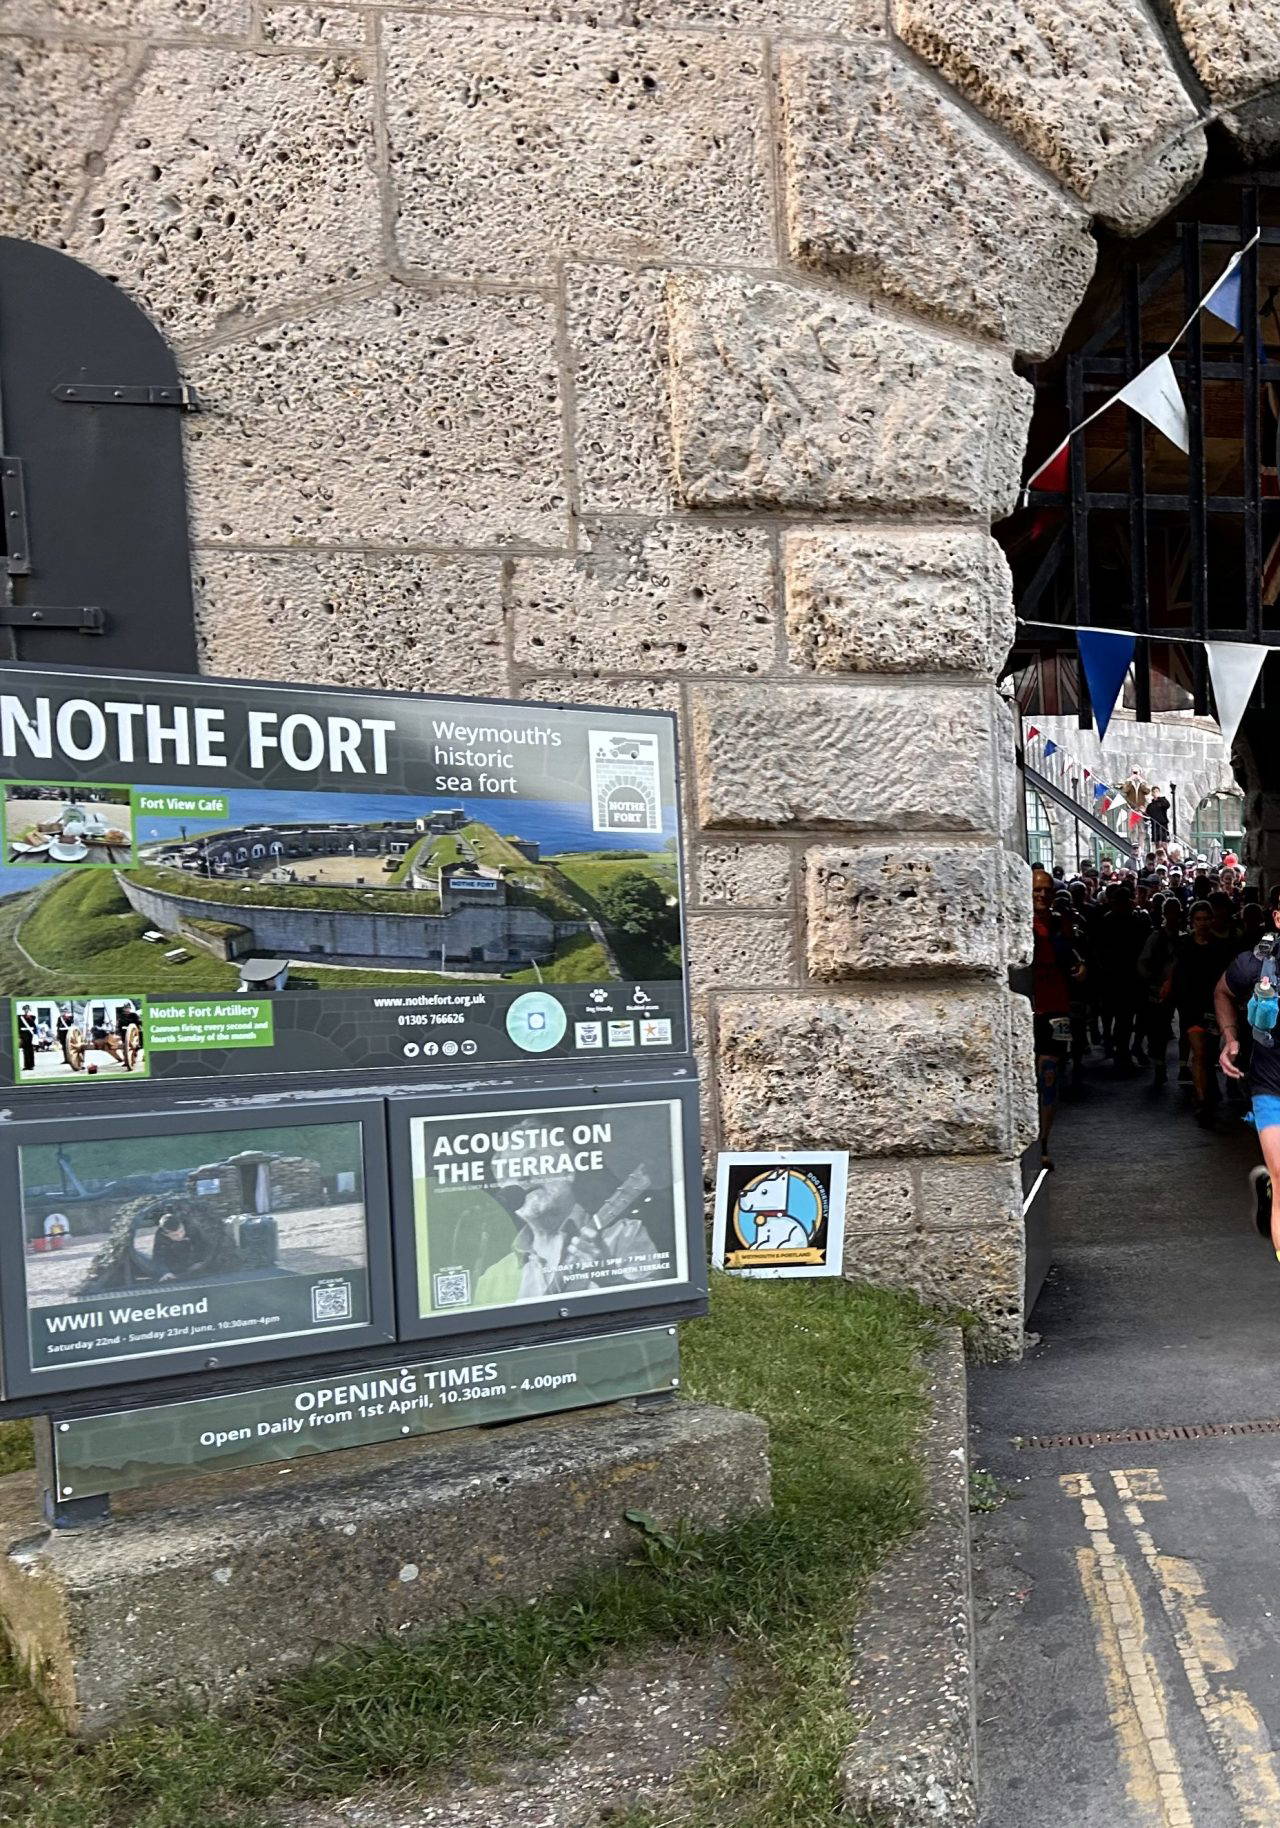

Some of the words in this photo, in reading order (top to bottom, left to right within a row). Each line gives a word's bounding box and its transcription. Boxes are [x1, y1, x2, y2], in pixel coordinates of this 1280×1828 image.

[0, 695, 228, 767] NOTHE
[249, 711, 396, 775] FORT
[432, 720, 562, 747] Weymouth's
[434, 746, 513, 769] historic
[435, 775, 472, 792] sea
[479, 773, 518, 794] fort
[140, 797, 164, 810] Fort
[166, 798, 195, 811] View
[198, 799, 224, 812] Café
[608, 801, 646, 812] NOTHE
[613, 813, 642, 823] FORT
[373, 993, 486, 1008] www.nothefort.org.uk
[149, 1007, 186, 1019] Nothe
[188, 1005, 212, 1018] Fort
[213, 1004, 259, 1018] Artillery
[397, 1014, 428, 1026] 01305
[429, 1012, 465, 1025] 766626
[150, 1025, 180, 1033] Cannon
[181, 1023, 203, 1034] firing
[204, 1023, 225, 1032] every
[226, 1021, 253, 1031] second
[254, 1021, 268, 1029] and
[150, 1035, 176, 1043] fourth
[177, 1033, 205, 1044] Sunday
[206, 1033, 216, 1041] of
[217, 1032, 230, 1041] the
[231, 1032, 256, 1040] month
[432, 1126, 566, 1158] ACOUSTIC
[571, 1122, 613, 1147] ON
[433, 1162, 486, 1186] THE
[491, 1150, 604, 1180] TERRACE
[652, 1251, 670, 1260] FREE
[563, 1272, 590, 1283] NOTHE
[590, 1269, 611, 1279] FORT
[612, 1266, 638, 1276] NORTH
[639, 1261, 671, 1272] TERRACE
[45, 1310, 104, 1334] WWII
[109, 1297, 209, 1326] Weekend
[47, 1340, 93, 1353] Saturday
[95, 1336, 120, 1346] 22nd
[128, 1329, 165, 1343] Sunday
[166, 1326, 189, 1337] 23rd
[294, 1374, 417, 1412] OPENING
[423, 1362, 499, 1390] TIMES
[199, 1427, 252, 1447] Open
[257, 1416, 304, 1437] Daily
[308, 1410, 353, 1427] from
[358, 1403, 384, 1418] 1st
[387, 1394, 434, 1414] April,
[438, 1384, 507, 1405] 10.30am
[520, 1372, 577, 1391] 4.00pm
